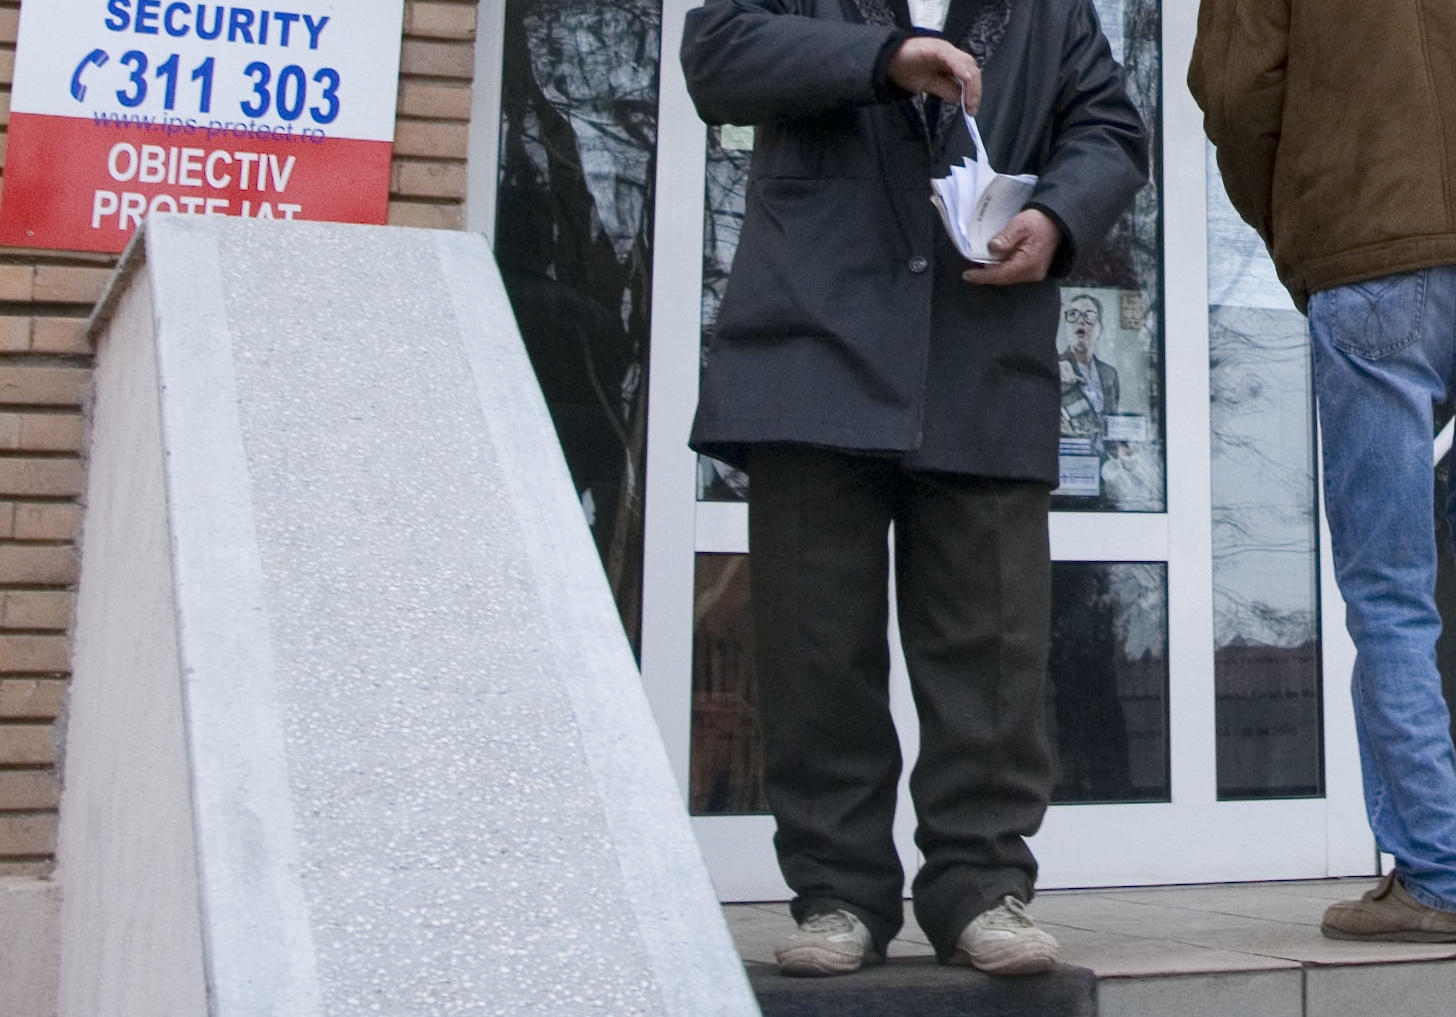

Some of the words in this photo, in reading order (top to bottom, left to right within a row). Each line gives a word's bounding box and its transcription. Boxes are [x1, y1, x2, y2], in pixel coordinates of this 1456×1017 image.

[115, 50, 216, 113] 311
[240, 61, 341, 124] 303
[93, 110, 326, 144] www.ips-protect.ro
[107, 142, 296, 192] OBIECTIV
